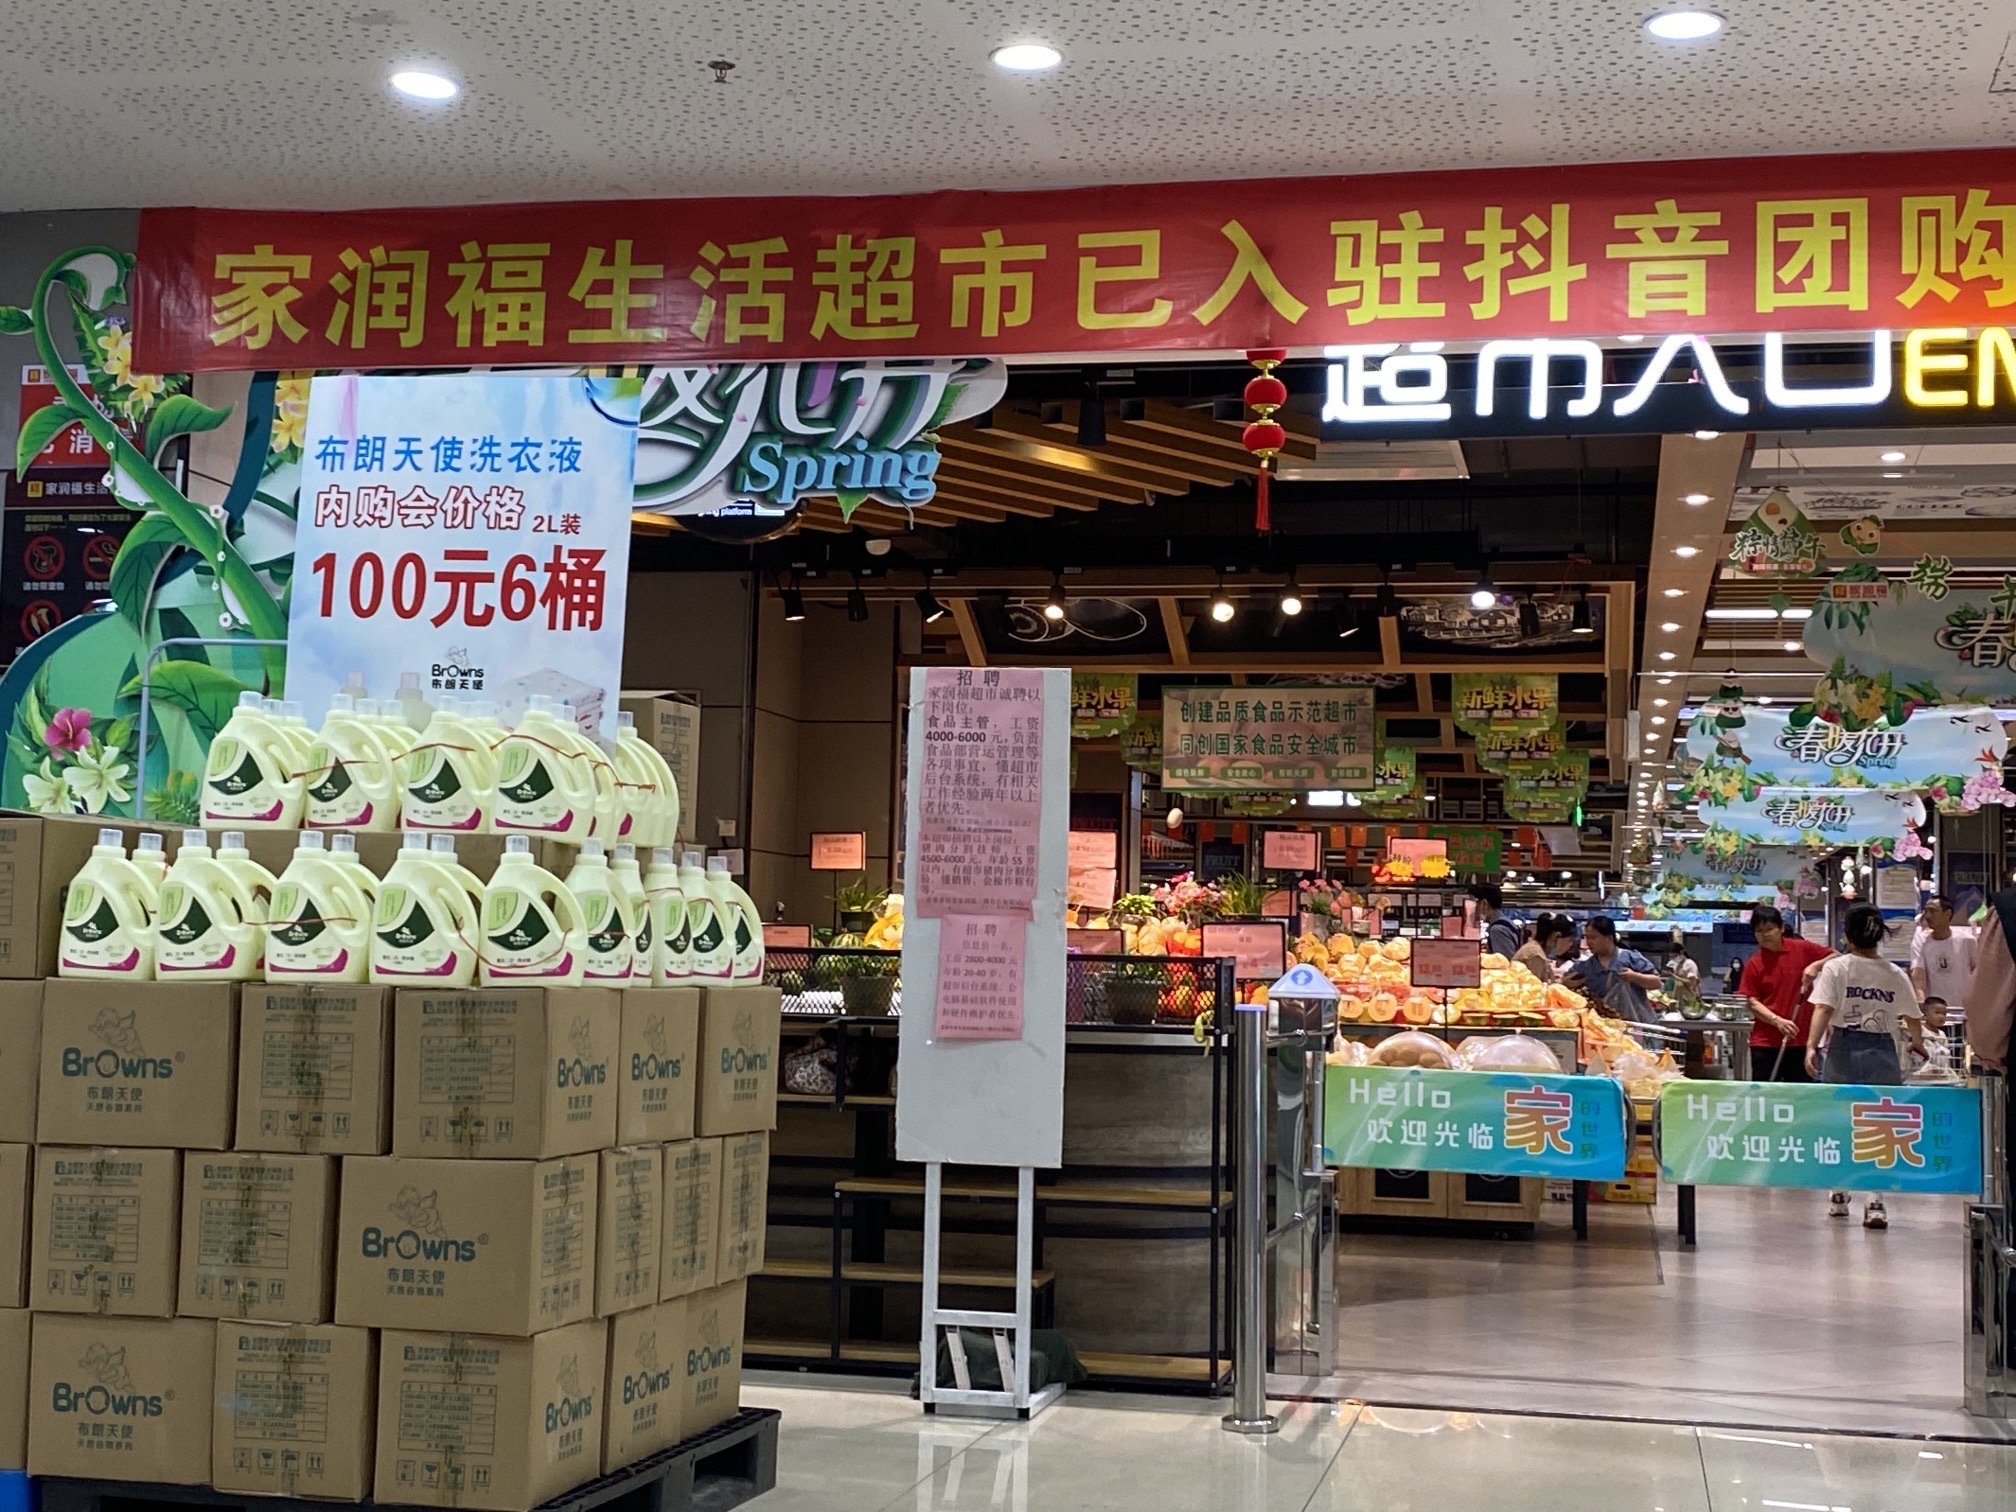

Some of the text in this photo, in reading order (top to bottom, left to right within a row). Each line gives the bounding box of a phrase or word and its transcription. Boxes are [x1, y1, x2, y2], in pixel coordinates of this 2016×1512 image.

[315, 434, 582, 473] 布朗天使洗衣液
[744, 438, 942, 505] Spring
[314, 484, 582, 535] 内购会价格 2L装
[312, 544, 607, 631] 100元6桶
[431, 678, 484, 691] 布朗天使
[956, 669, 1000, 687] 招聘
[1180, 700, 1358, 723] 创建品质食品示范超市
[1461, 685, 1556, 709] 新鲜水果
[1179, 733, 1357, 756] 同创国家食品安全城市
[924, 786, 1038, 803] 工作经验两年以上
[1350, 1078, 1451, 1108] Hello
[1687, 1093, 1795, 1123] Hello
[1367, 1118, 1494, 1150] 欢迎光临
[1504, 1085, 1573, 1155] 家
[1851, 1096, 1925, 1169] 家
[1707, 1135, 1841, 1165] 欢迎光临
